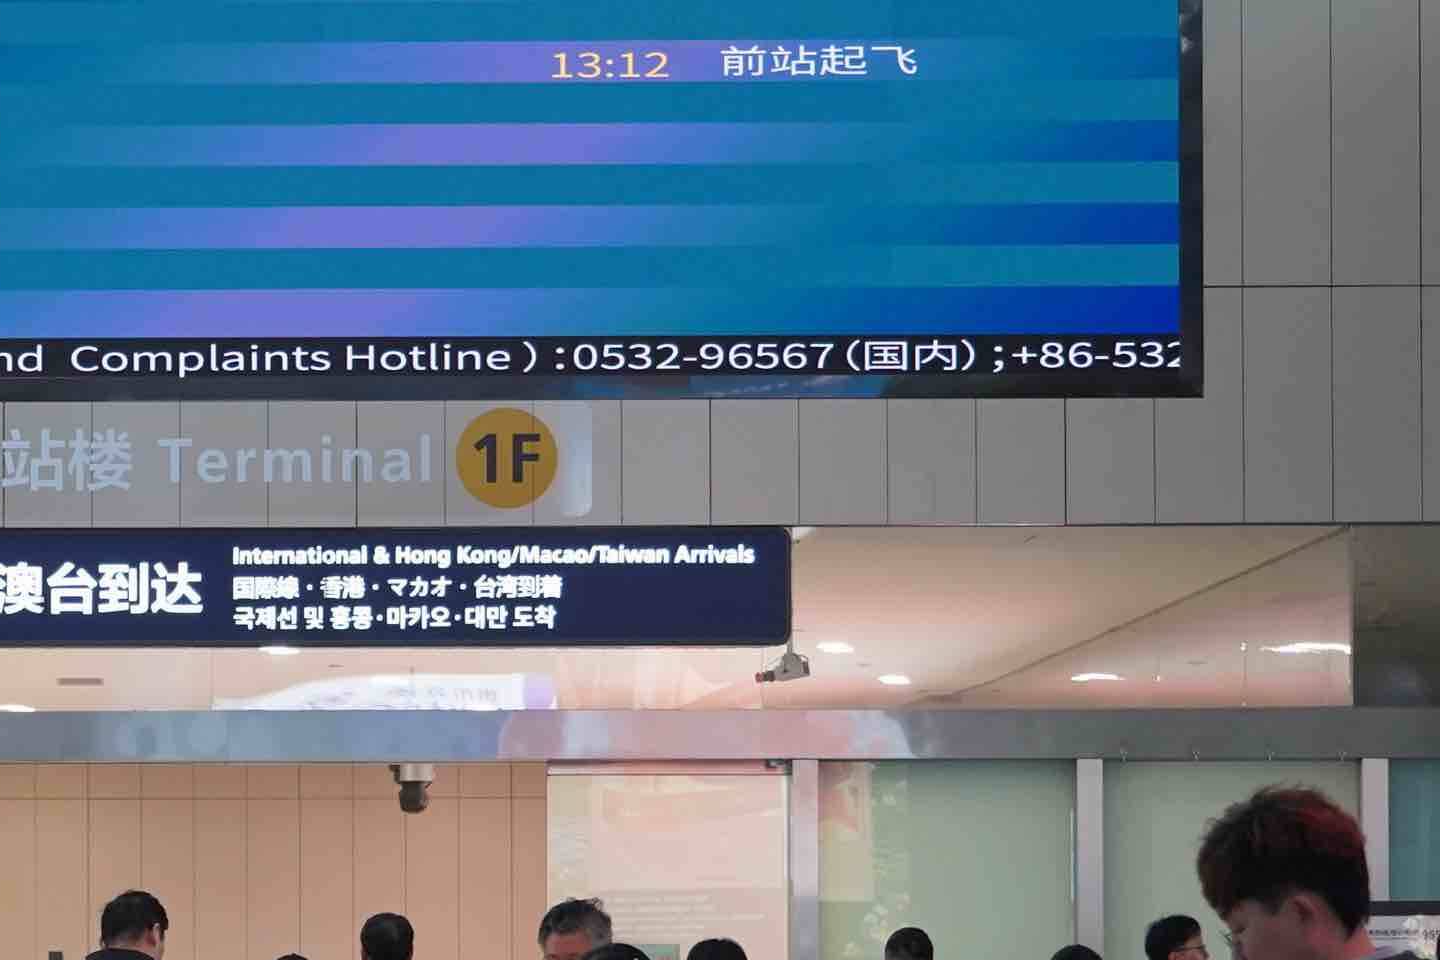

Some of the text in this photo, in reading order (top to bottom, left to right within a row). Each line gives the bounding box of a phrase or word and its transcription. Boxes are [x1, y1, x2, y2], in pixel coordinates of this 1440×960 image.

[551, 52, 669, 78] 13:12
[720, 45, 917, 76] 前站起飞
[70, 343, 331, 379] Complaints
[157, 434, 432, 485] Terminal
[472, 433, 542, 484] 1F
[232, 543, 756, 569] International & Hong Kong/Macao/Taiwan Arrivals
[232, 605, 298, 631] 국제선
[303, 605, 324, 630] 및
[512, 604, 557, 630] 도착
